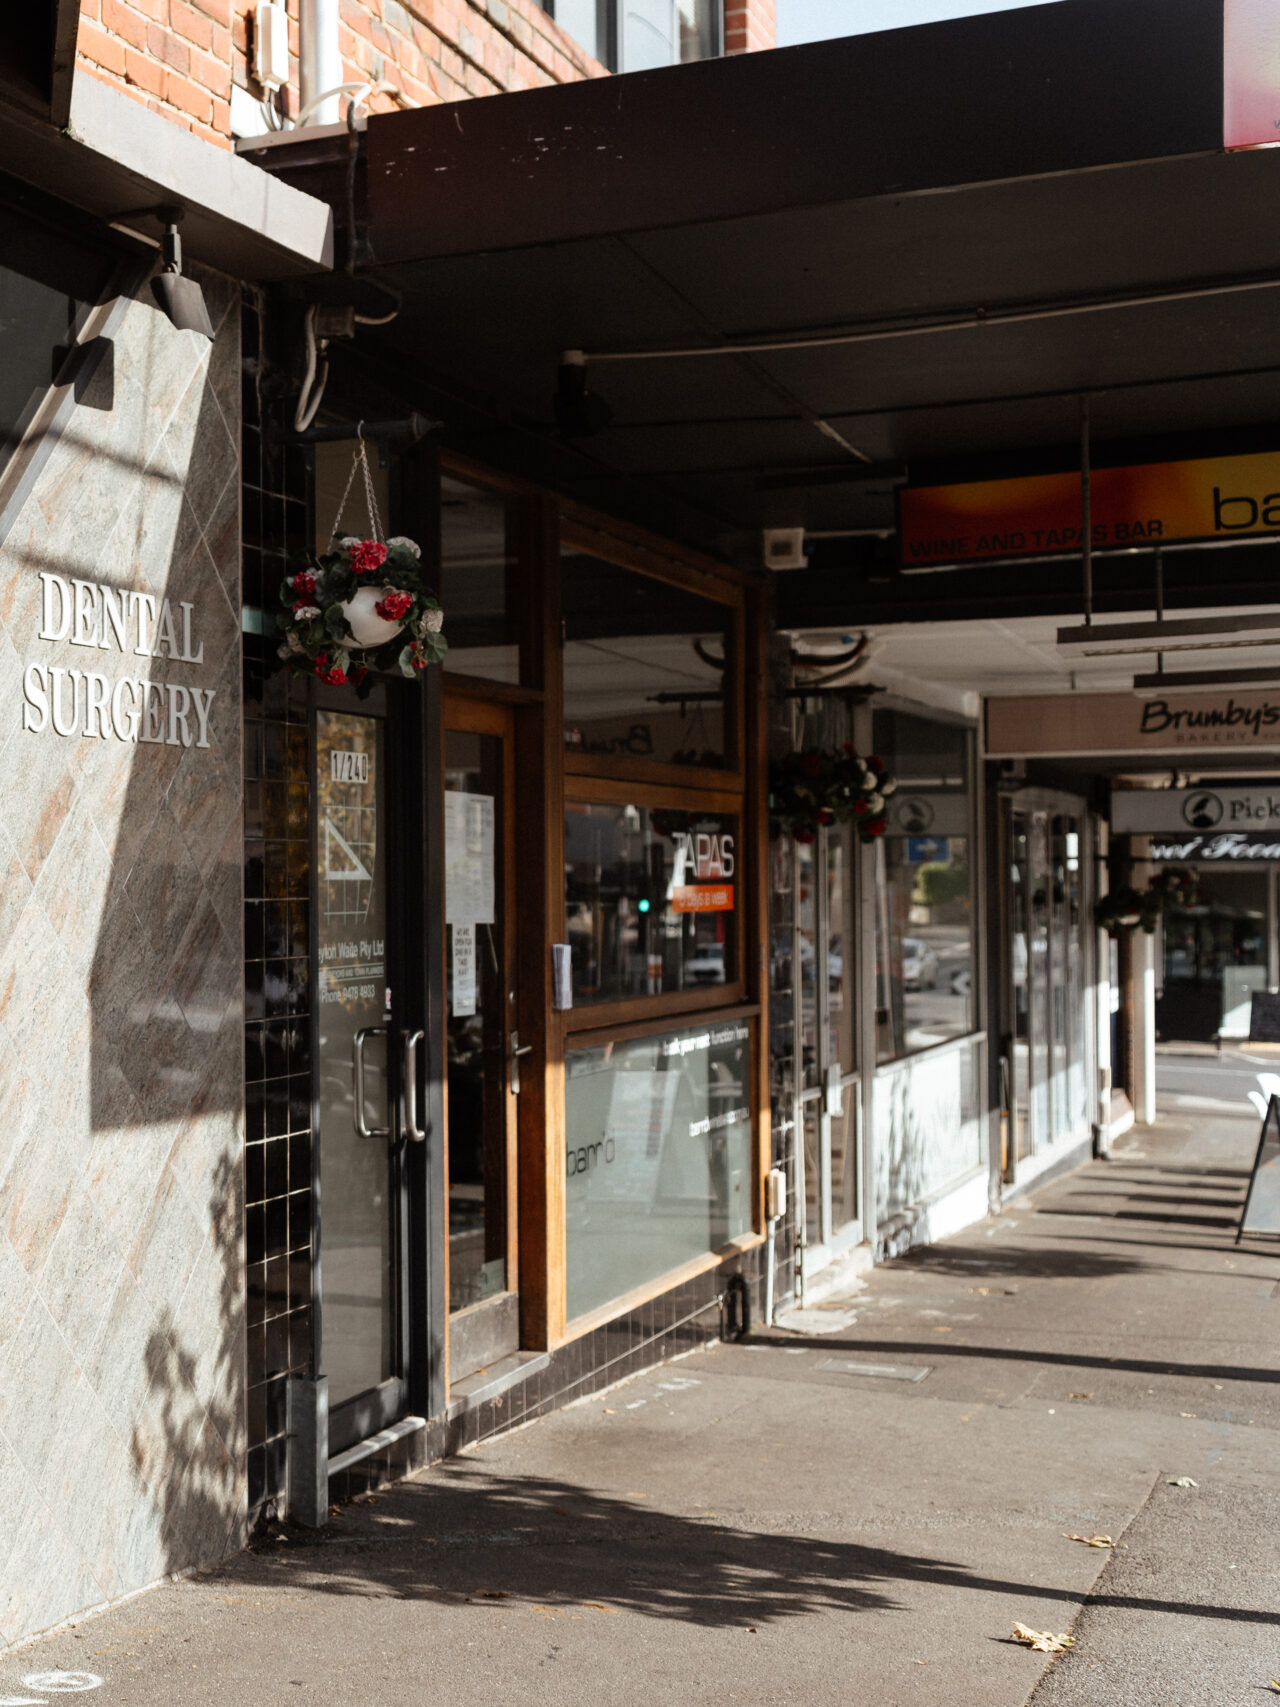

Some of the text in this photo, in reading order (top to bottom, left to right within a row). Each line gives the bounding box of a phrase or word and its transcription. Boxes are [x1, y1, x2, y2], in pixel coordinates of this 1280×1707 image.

[909, 537, 969, 558] WINE
[976, 531, 1025, 553] AND
[1114, 519, 1163, 541] BAR
[38, 572, 204, 664] DENTAL
[22, 662, 216, 749] SURGERY
[1139, 699, 1280, 735] Brumby's
[1176, 731, 1247, 743] BAKERY
[332, 752, 367, 781] 1/240
[672, 831, 734, 878] TAPAS
[359, 940, 372, 960] Pty
[373, 938, 384, 956] Ltd
[321, 989, 341, 1004] Phone
